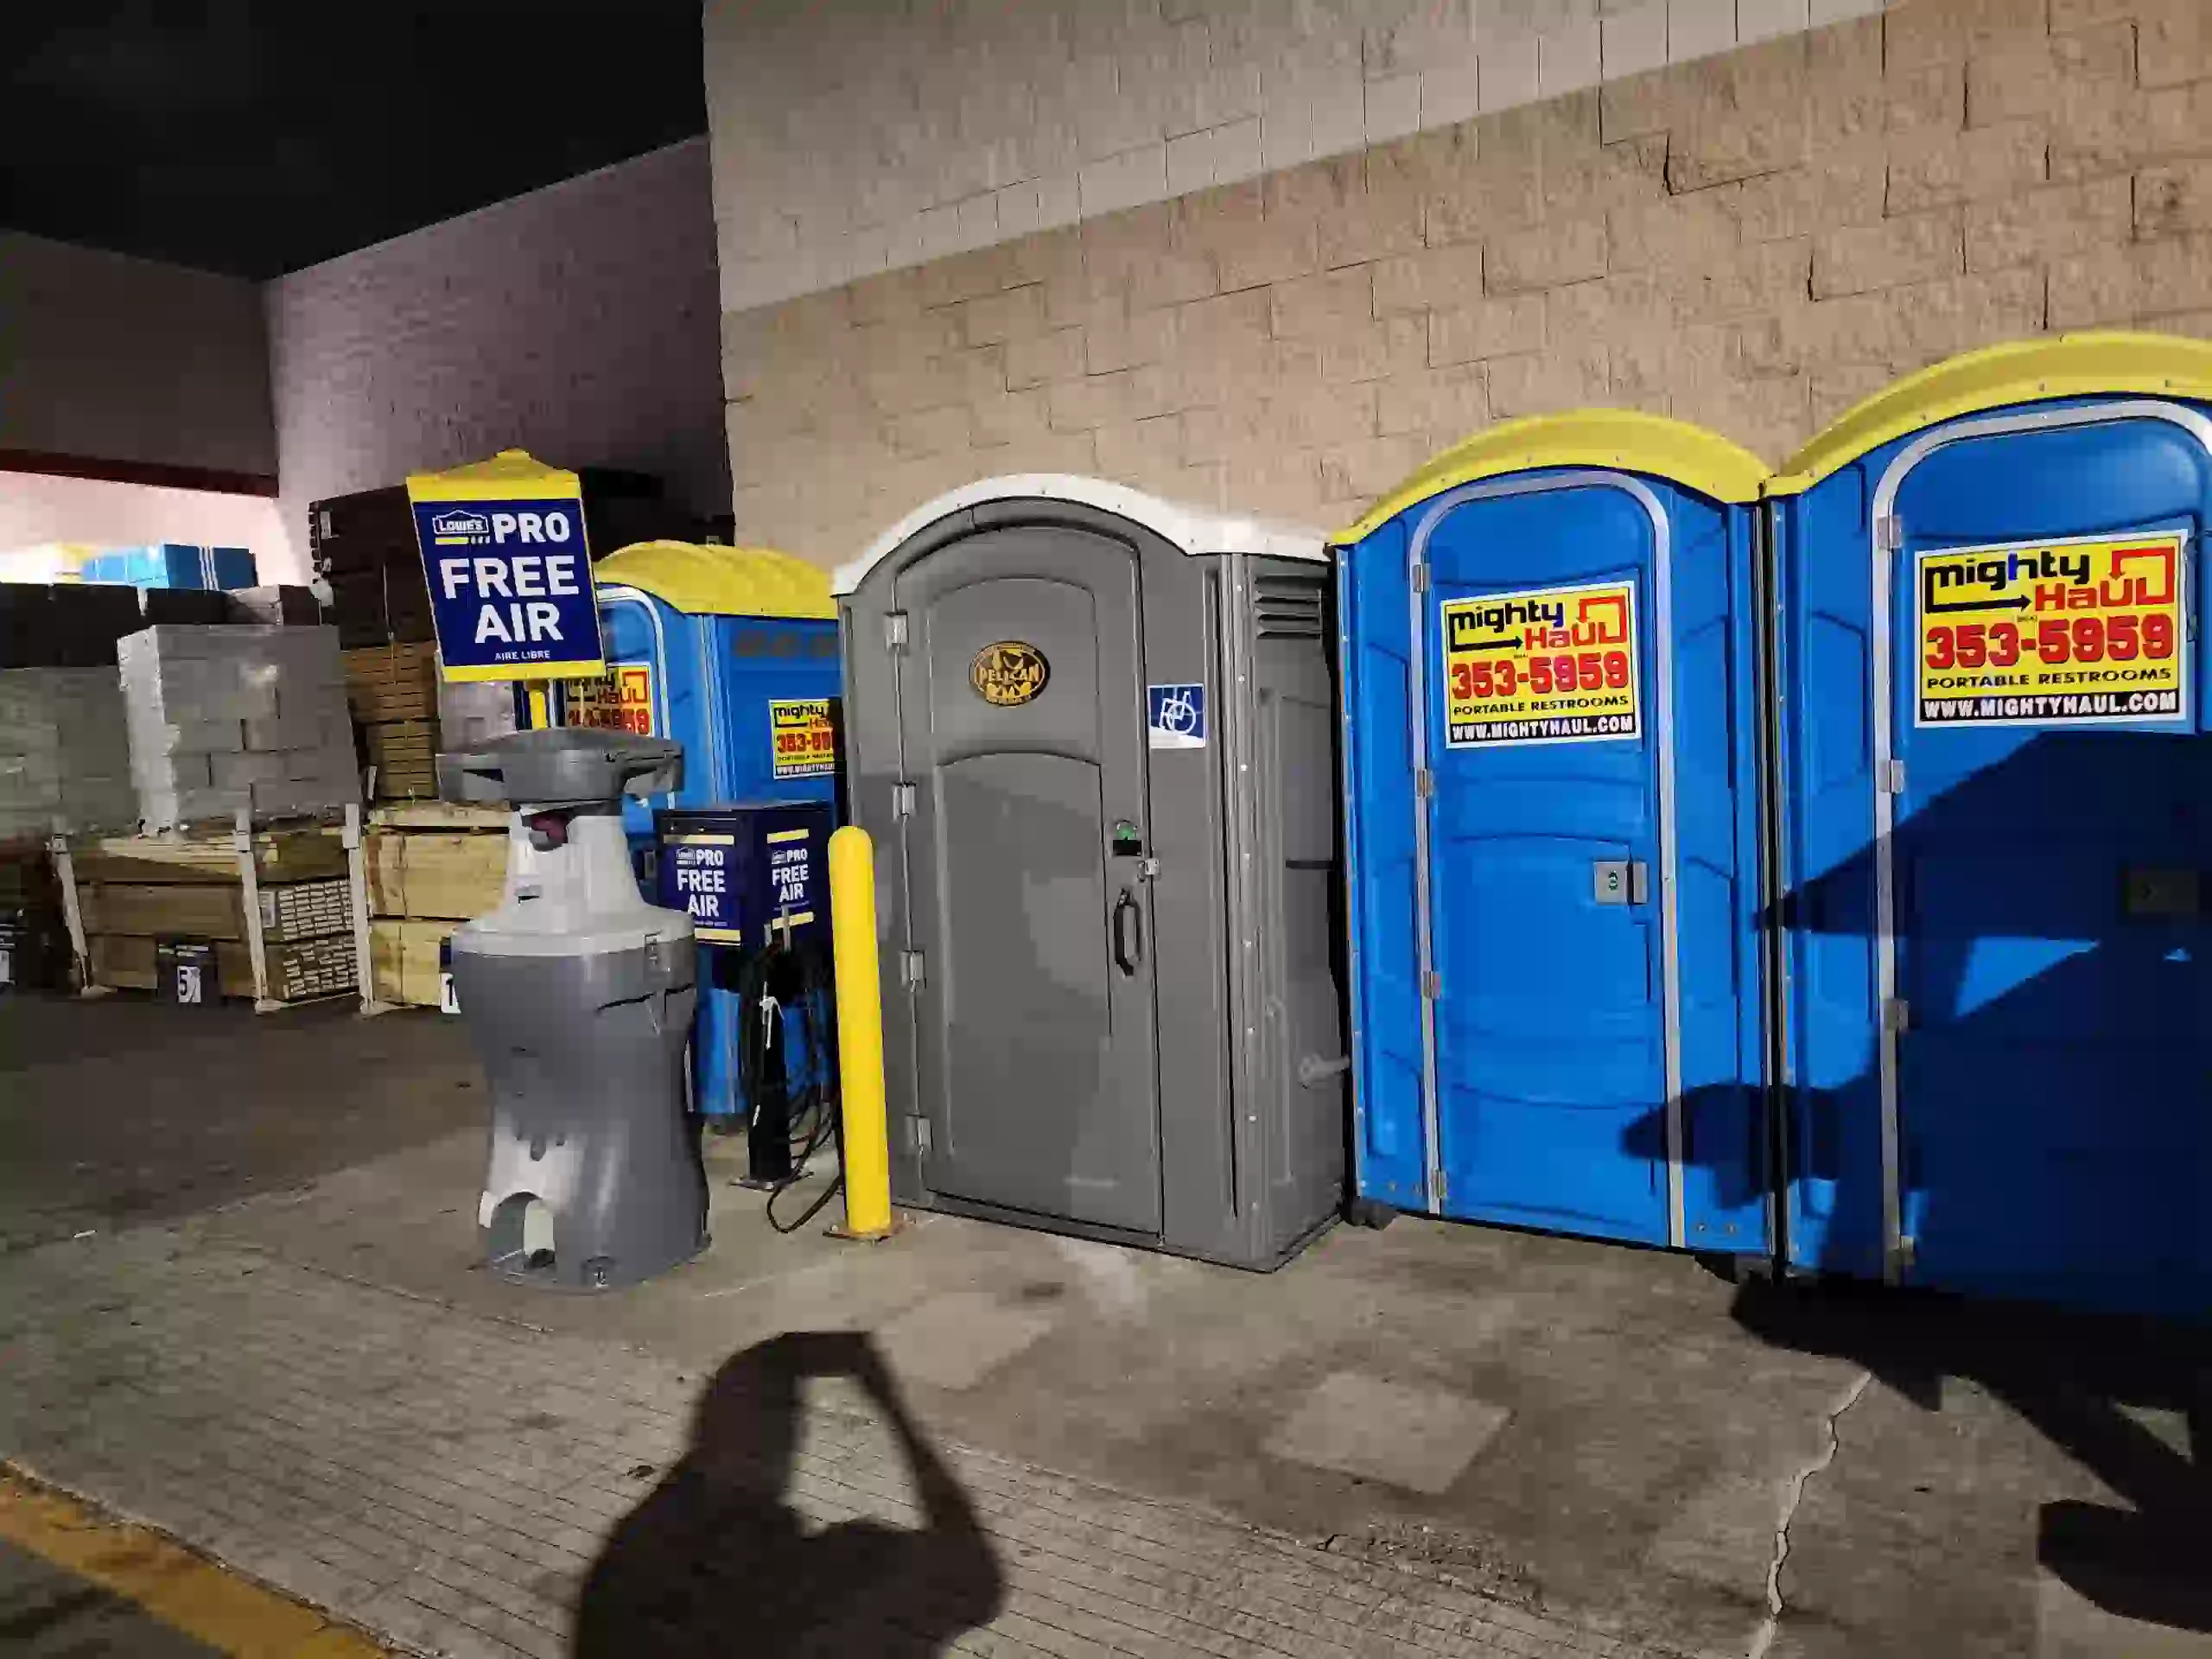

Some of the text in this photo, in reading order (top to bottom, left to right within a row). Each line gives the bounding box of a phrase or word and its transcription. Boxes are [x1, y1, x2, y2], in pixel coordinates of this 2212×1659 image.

[438, 512, 569, 543] LOWE'S PRO
[440, 556, 579, 599] FREE
[1924, 550, 2090, 591] mighty
[475, 602, 563, 643] AIR
[1448, 600, 1565, 632] mighty
[1925, 613, 2175, 670] 353-5959
[495, 650, 550, 660] AIRE LIBRE
[979, 663, 1039, 685] PELICAN
[1452, 651, 1629, 700] 353-5959
[1927, 668, 2171, 689] PORTABLE RESTROOMS
[1453, 696, 1629, 716] PORTABLE RESTROOMS
[1924, 692, 2177, 720] WWW.MIGHTYHAUL.COM
[1452, 715, 1633, 741] WWW.MIGHTYHAUL.COM
[696, 849, 724, 867] PRO
[787, 849, 808, 862] PRO
[677, 868, 727, 893] FREE
[772, 864, 810, 887] FREE
[688, 894, 720, 917] AIR
[779, 883, 804, 903] AIR
